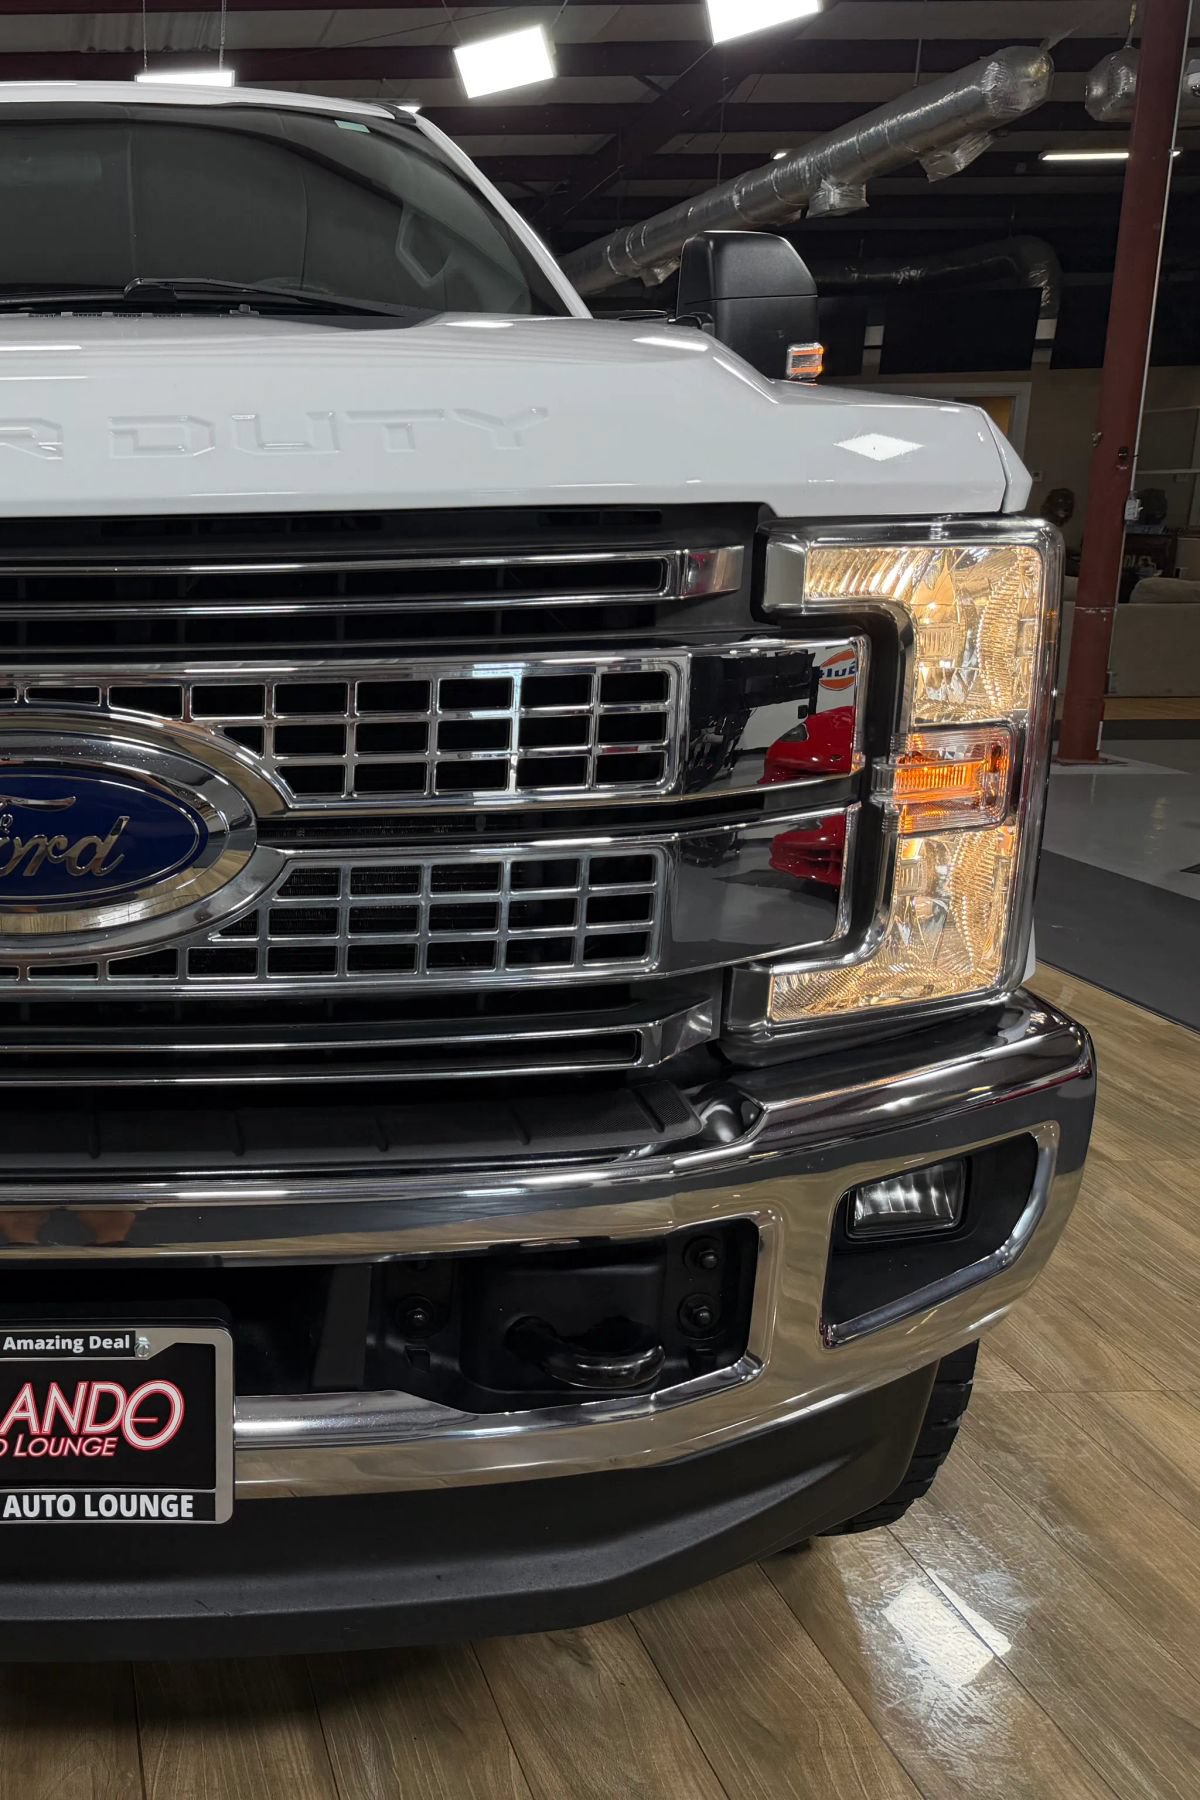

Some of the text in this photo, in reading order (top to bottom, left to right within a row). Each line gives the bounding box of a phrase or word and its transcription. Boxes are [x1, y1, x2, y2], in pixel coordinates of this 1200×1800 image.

[107, 406, 550, 460] DUTY
[3, 1335, 84, 1353] Amazing
[89, 1334, 130, 1350] Deal
[12, 1432, 119, 1457] LOUNGE
[3, 1494, 77, 1519] AUTO
[83, 1494, 194, 1519] LOUNGE
